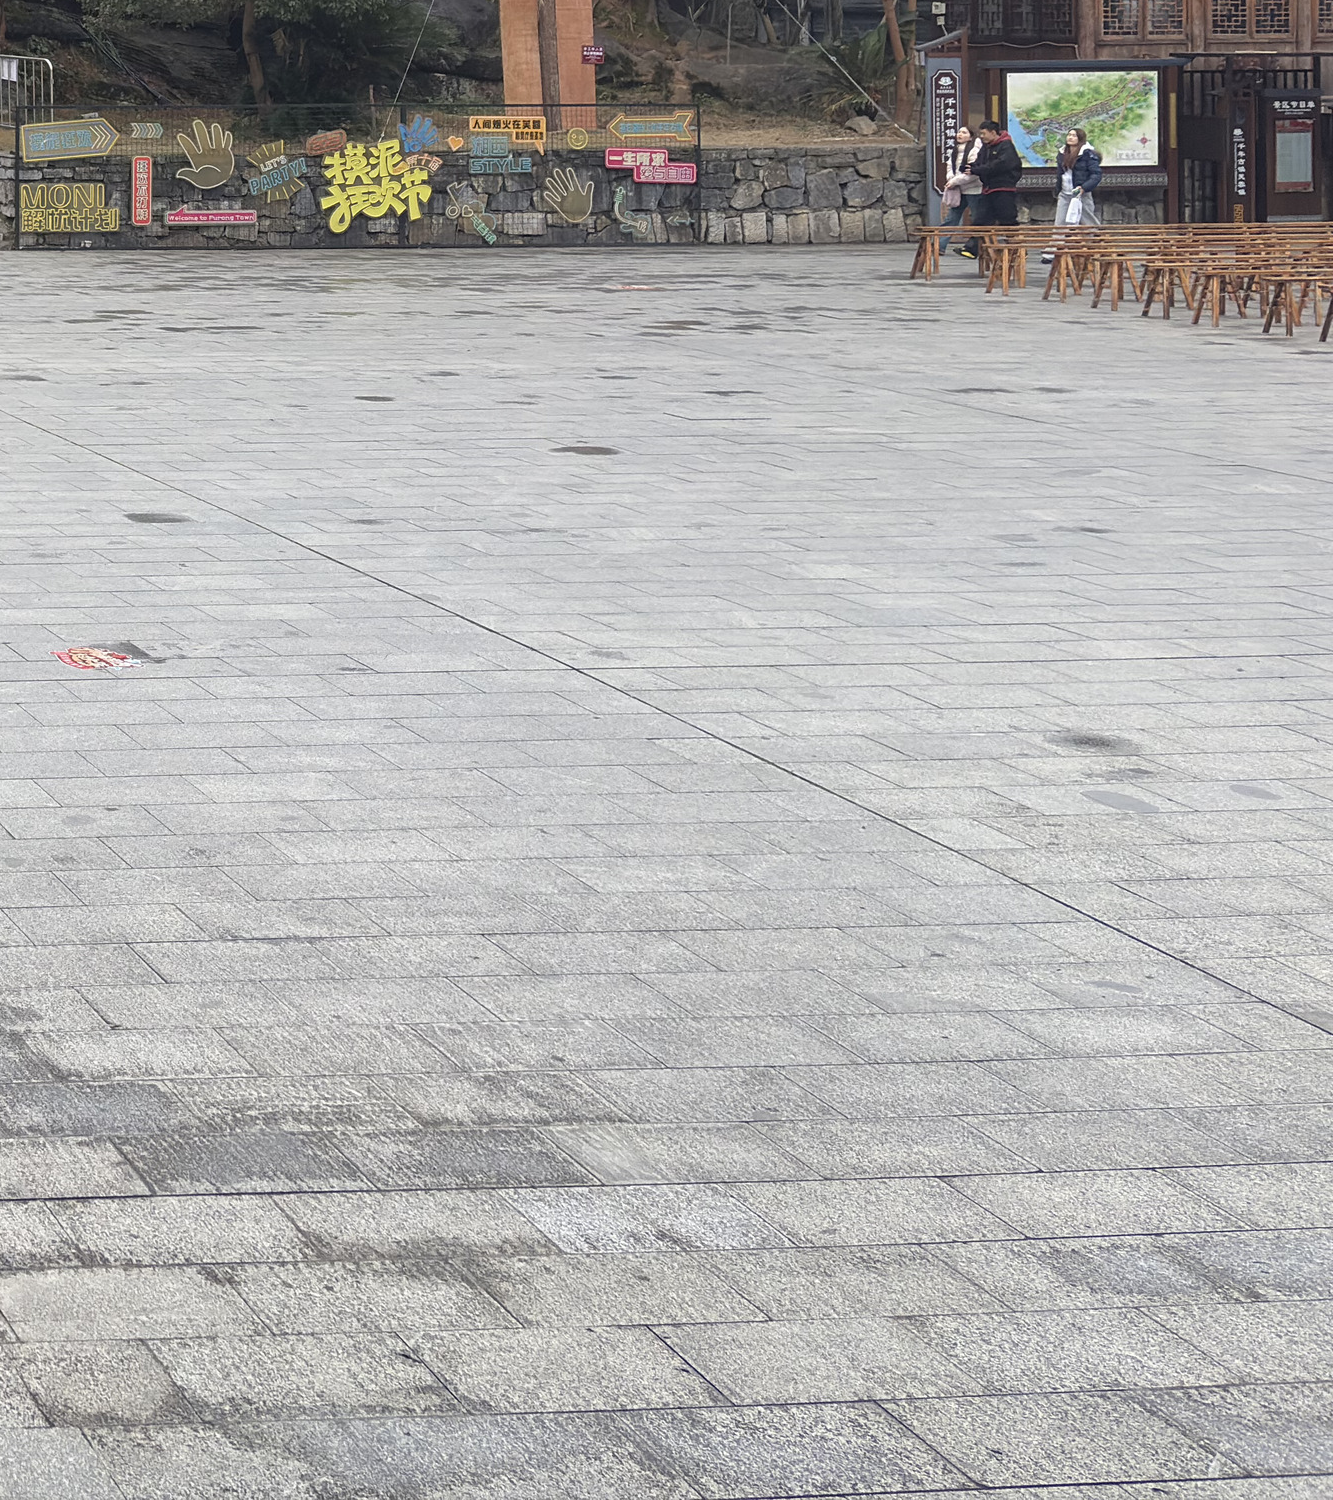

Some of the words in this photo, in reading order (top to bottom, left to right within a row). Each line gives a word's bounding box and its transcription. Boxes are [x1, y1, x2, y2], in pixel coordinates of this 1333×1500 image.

[471, 137, 508, 156] 湘西
[260, 155, 287, 172] LET'S
[323, 139, 408, 185] 摸泥
[406, 153, 443, 171] 第十届
[470, 158, 531, 173] STYLE
[609, 151, 665, 166] 一生所求
[250, 157, 307, 196] PARTY!
[640, 166, 693, 180] 爱与自由
[21, 184, 105, 209] MONI
[321, 167, 432, 233] 狂欢节
[21, 209, 119, 232] 解忧计划
